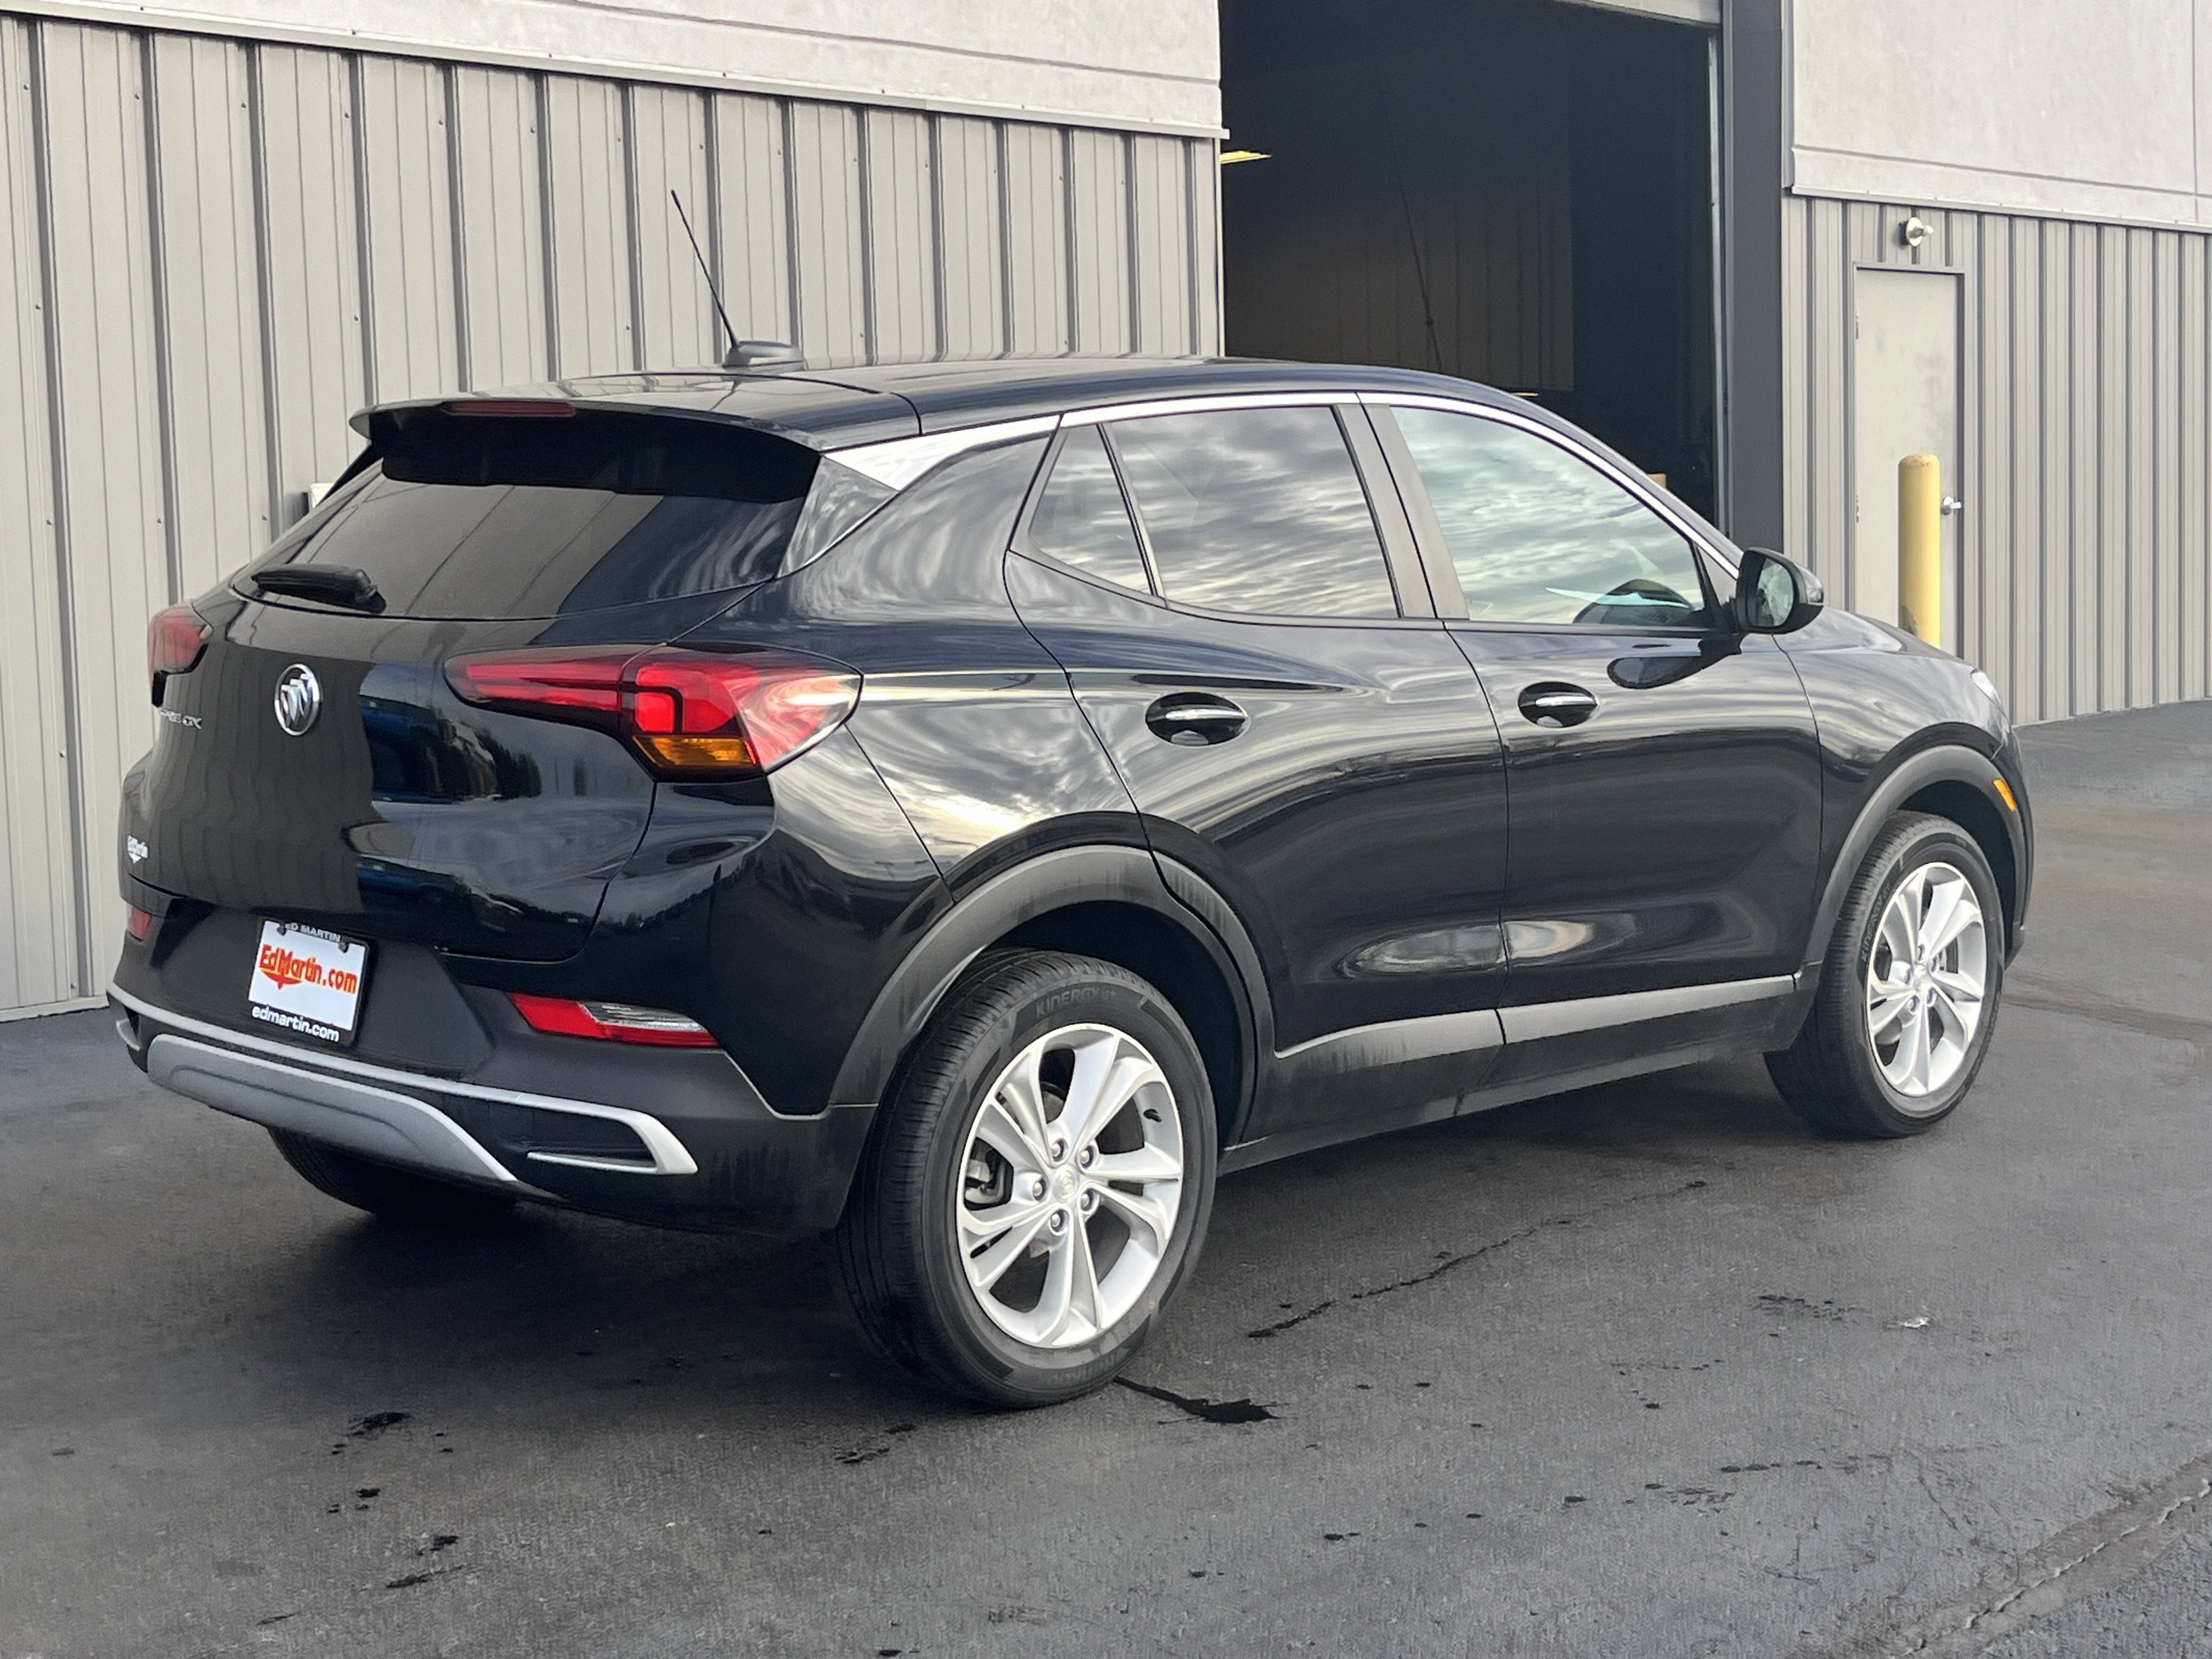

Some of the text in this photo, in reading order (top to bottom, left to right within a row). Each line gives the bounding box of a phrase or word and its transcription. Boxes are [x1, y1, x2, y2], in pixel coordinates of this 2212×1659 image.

[300, 924, 341, 943] MARTIN
[259, 944, 358, 995] EdMartin.com
[251, 1005, 340, 1042] edmartin.com
